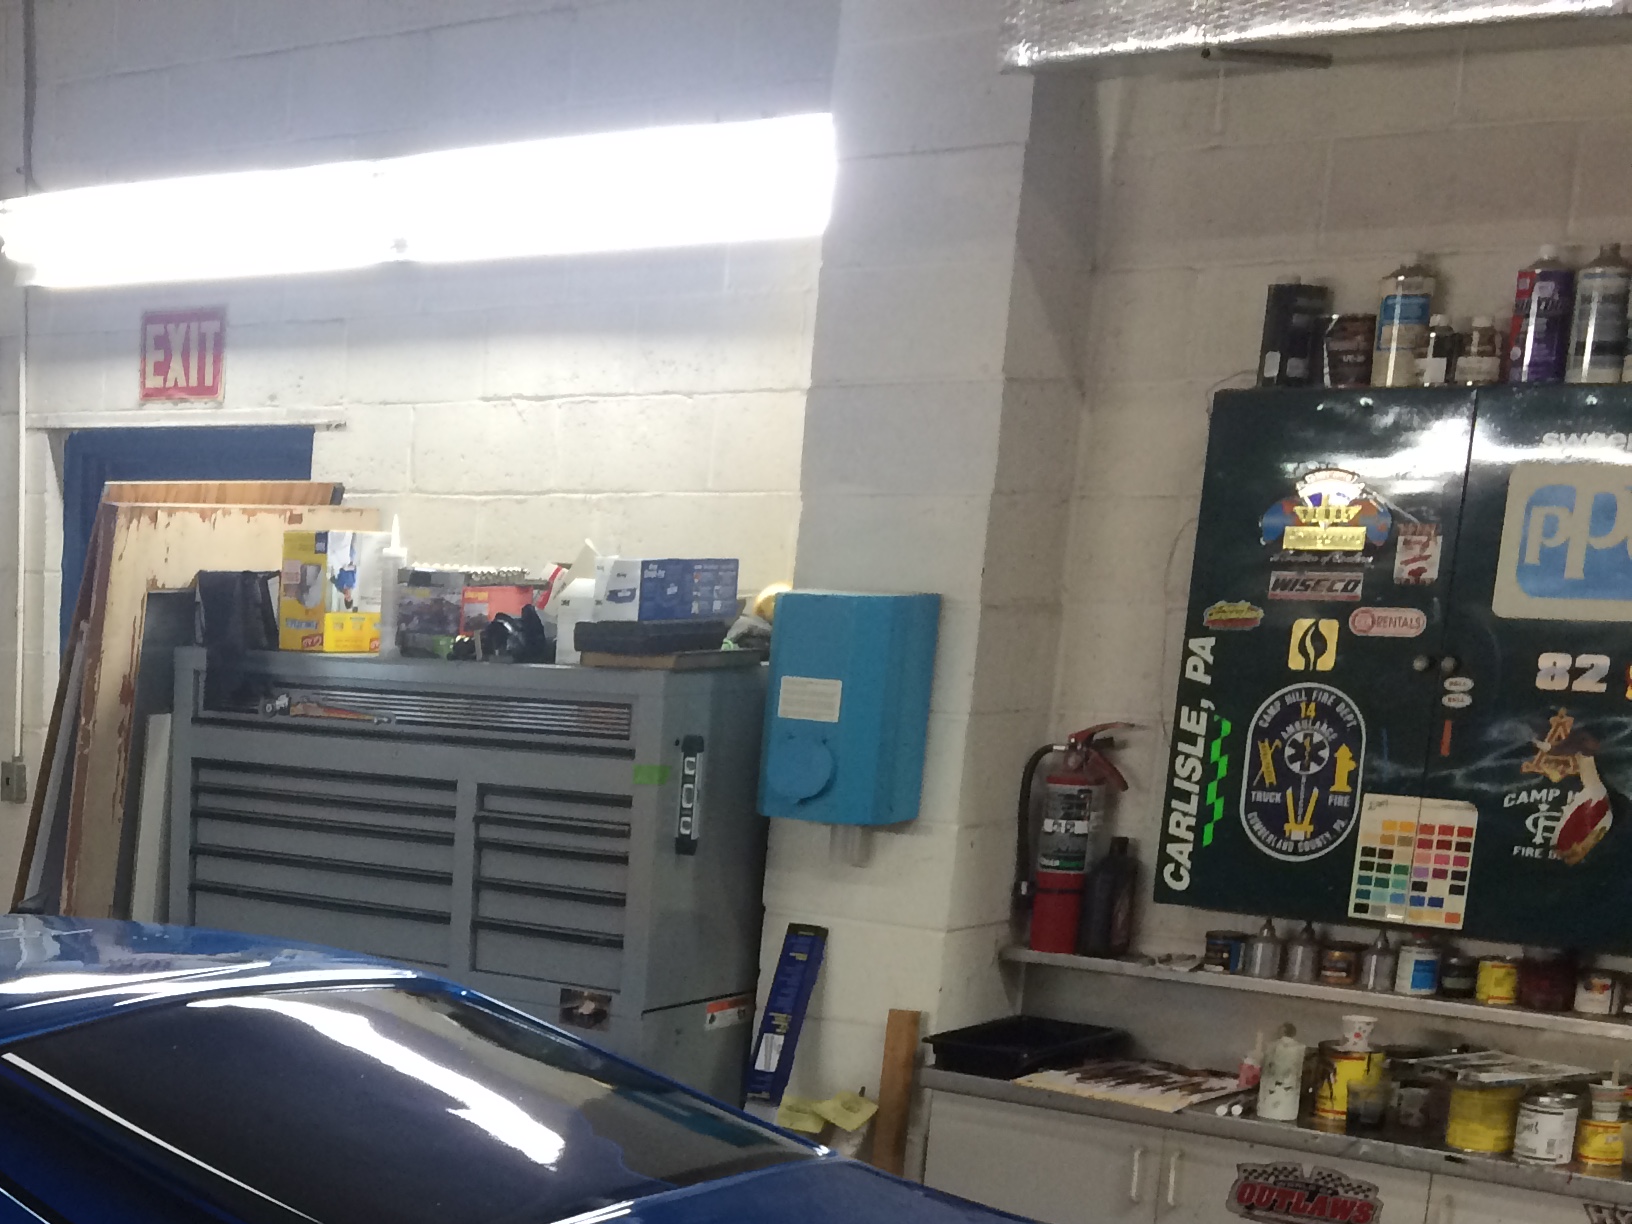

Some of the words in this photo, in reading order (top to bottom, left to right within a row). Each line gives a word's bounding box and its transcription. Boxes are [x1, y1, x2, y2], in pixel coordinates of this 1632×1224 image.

[145, 320, 222, 391] EXIT
[1270, 578, 1362, 593] WISECO
[1375, 616, 1422, 630] RENTALS
[1185, 636, 1217, 686] PA
[1534, 652, 1611, 693] 82
[1258, 700, 1282, 729] CAMP
[1284, 689, 1308, 706] HILL
[1312, 689, 1337, 707] FIRE
[1299, 701, 1317, 719] 14
[1163, 698, 1216, 892] CARLISLE,
[1251, 790, 1282, 804] TRUCK
[1327, 794, 1351, 808] FIRE
[1503, 788, 1561, 808] CAMP
[1512, 845, 1543, 860] FIRE
[1236, 1182, 1375, 1224] OUTLAWS
